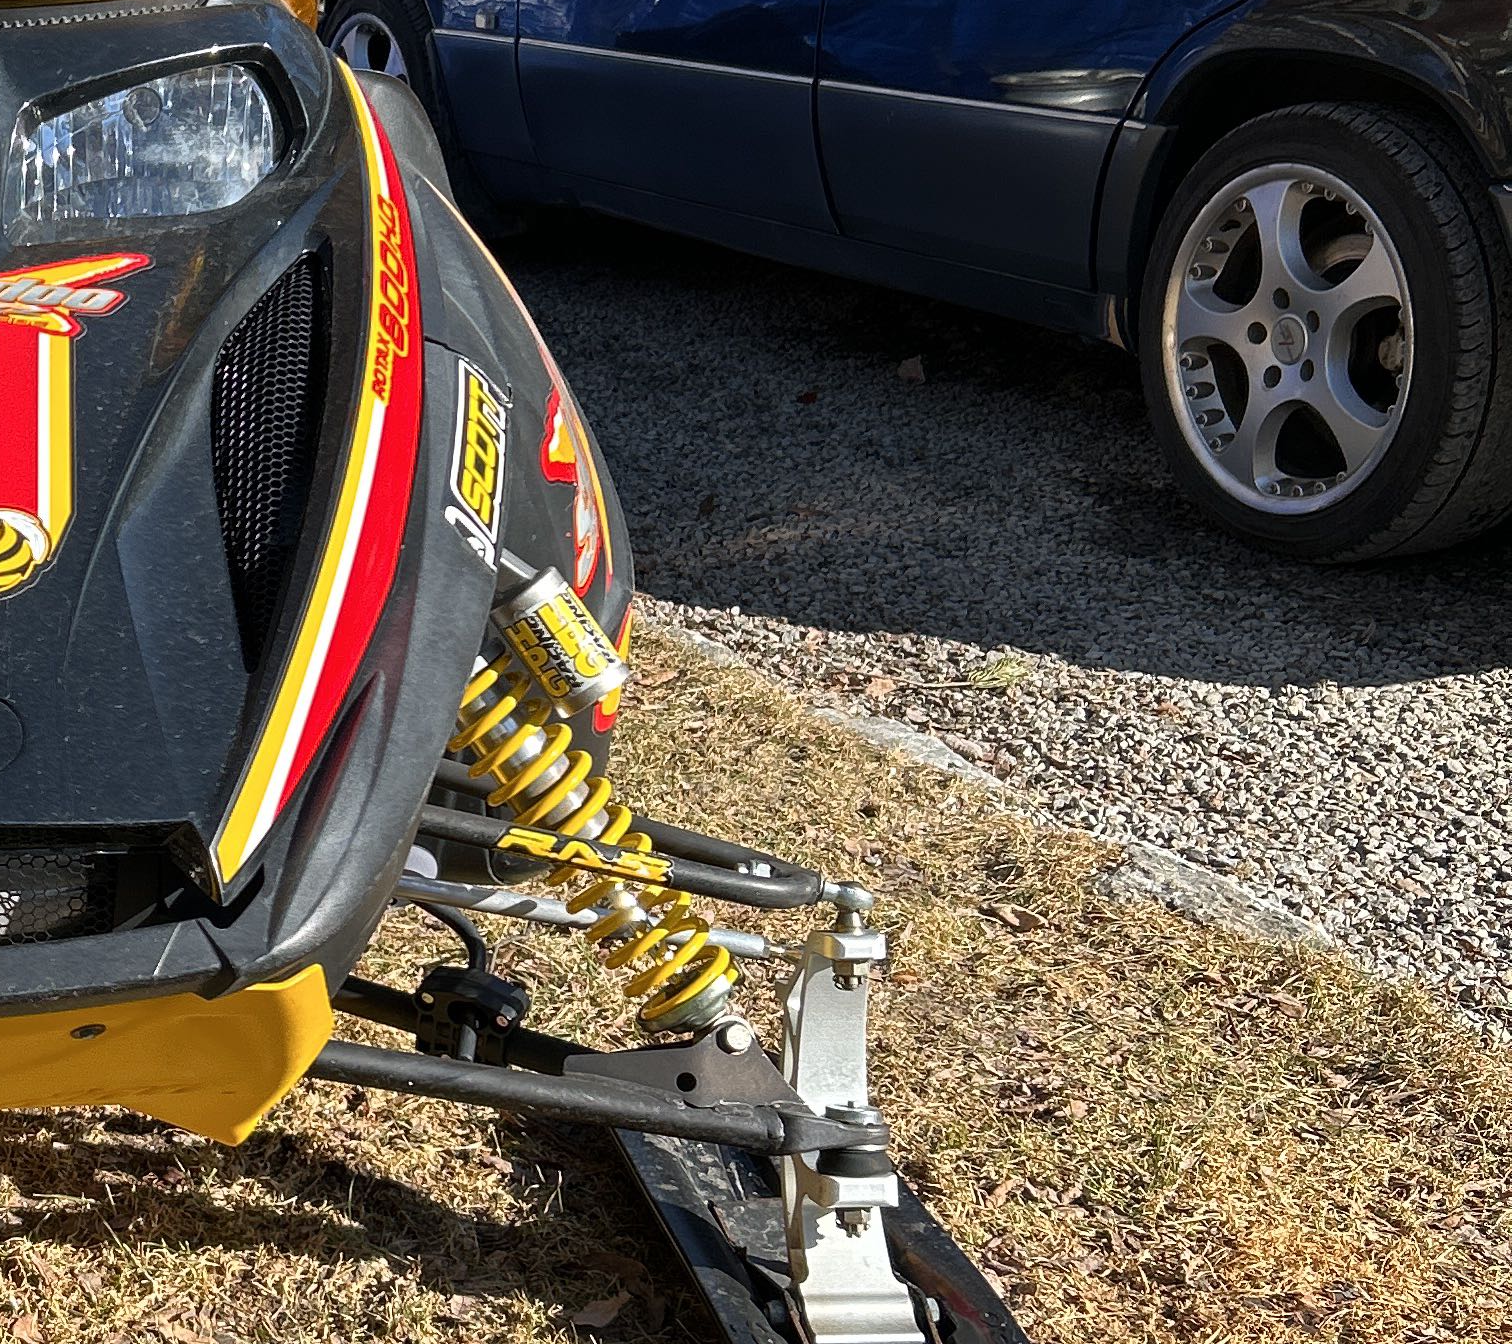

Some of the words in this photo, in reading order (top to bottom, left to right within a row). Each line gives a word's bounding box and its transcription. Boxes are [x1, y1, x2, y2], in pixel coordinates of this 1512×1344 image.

[378, 243, 407, 353] 800
[372, 327, 390, 402] ROTAX
[461, 372, 501, 524] SCOTT
[505, 619, 571, 698] HPG
[525, 611, 584, 689] RACING
